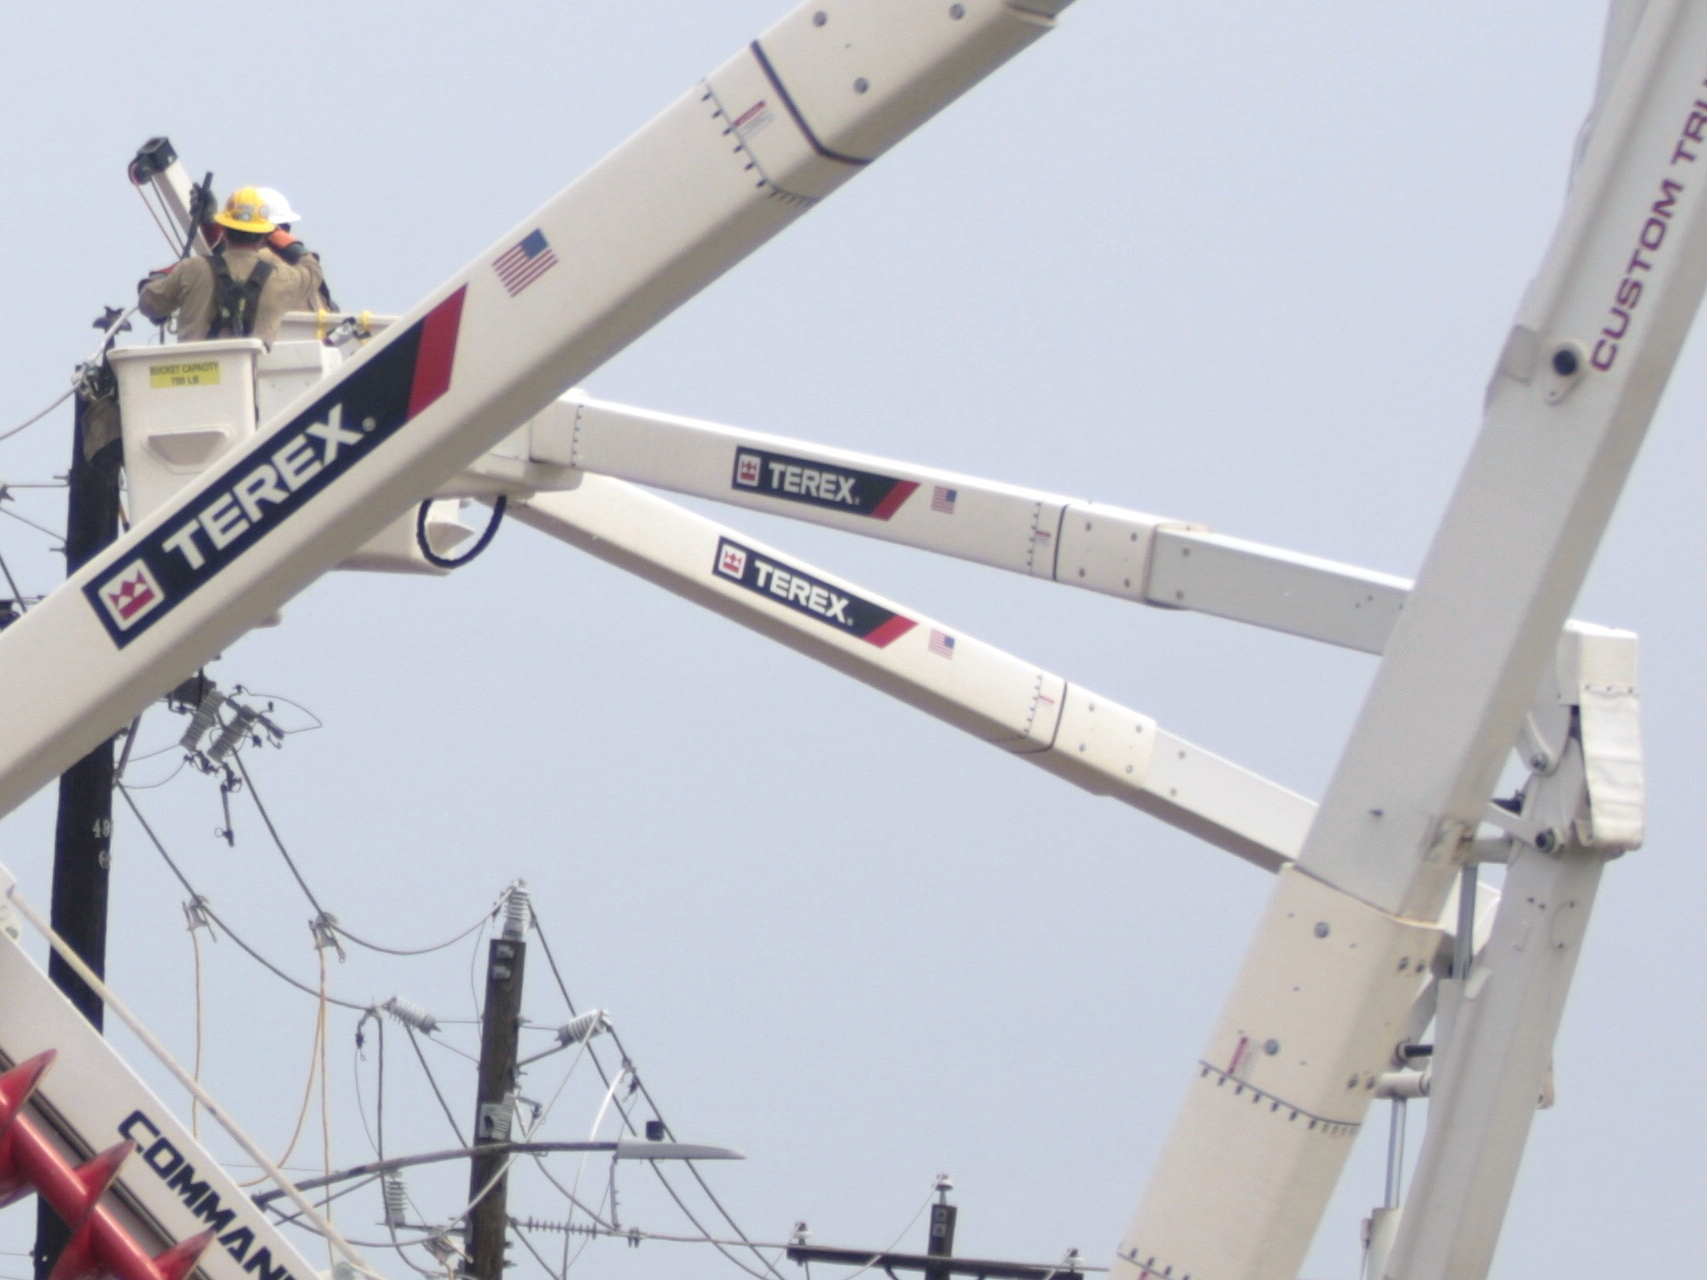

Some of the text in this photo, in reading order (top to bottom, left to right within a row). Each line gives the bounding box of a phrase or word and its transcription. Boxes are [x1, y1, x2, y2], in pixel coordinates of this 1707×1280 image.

[1589, 178, 1685, 372] CUSTOM
[161, 402, 365, 571] TEREX
[768, 461, 856, 505] TEREX
[754, 559, 849, 624] TEREX
